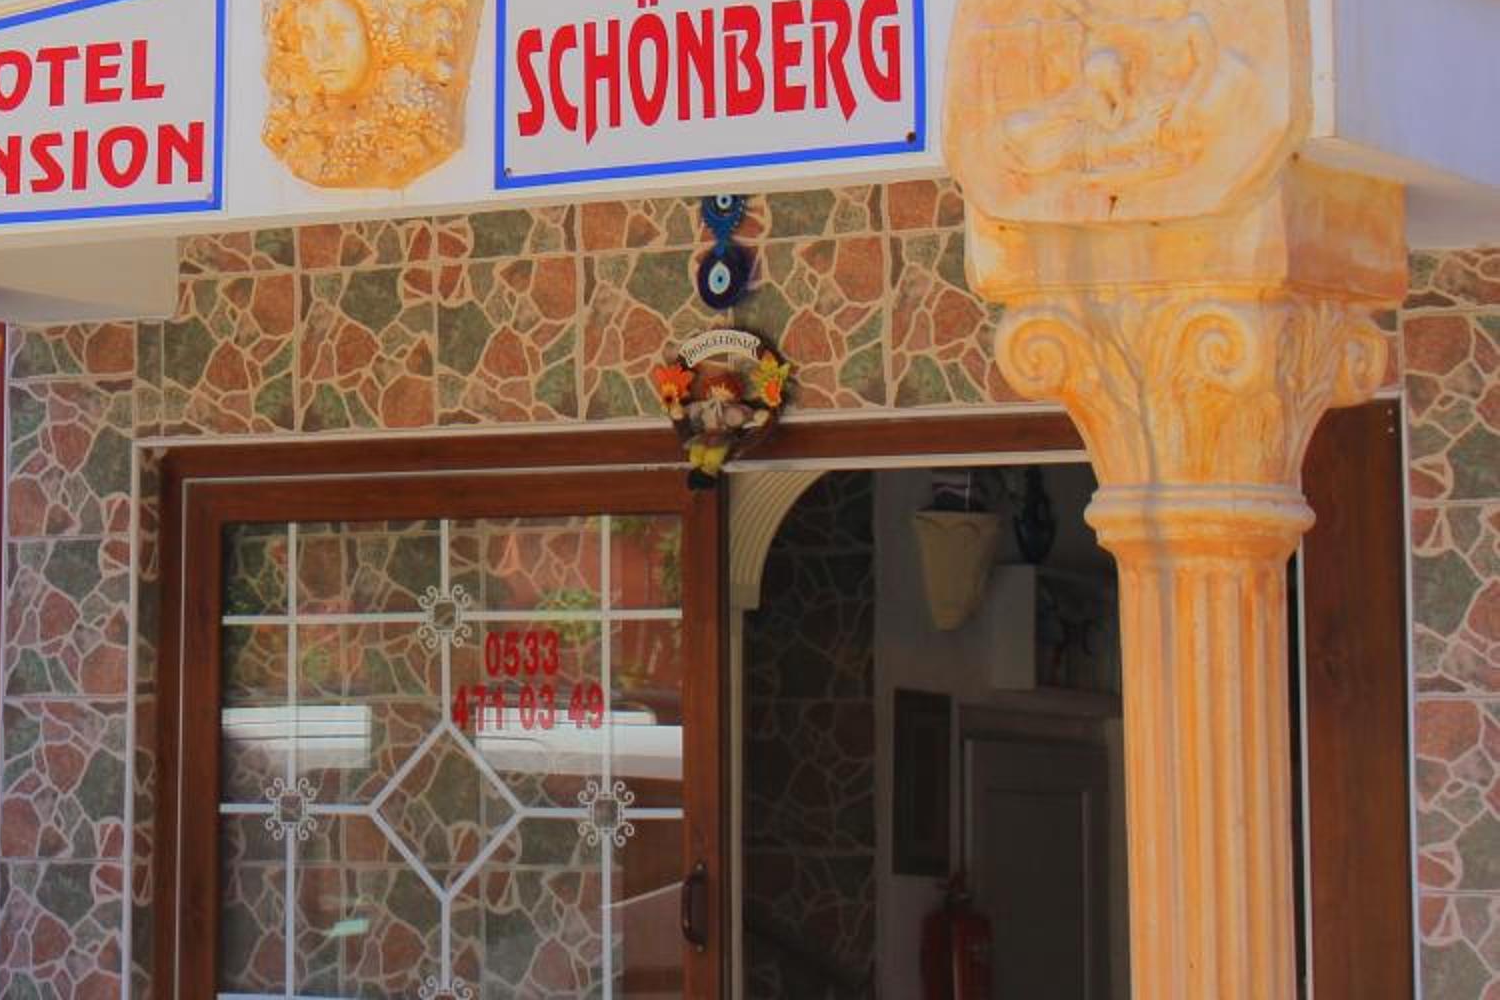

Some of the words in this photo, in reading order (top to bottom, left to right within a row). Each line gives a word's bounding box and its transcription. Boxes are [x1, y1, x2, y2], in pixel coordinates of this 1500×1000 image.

[484, 630, 561, 678] 0533
[452, 682, 505, 732] 471
[518, 681, 556, 731] 03
[568, 679, 605, 730] 49
